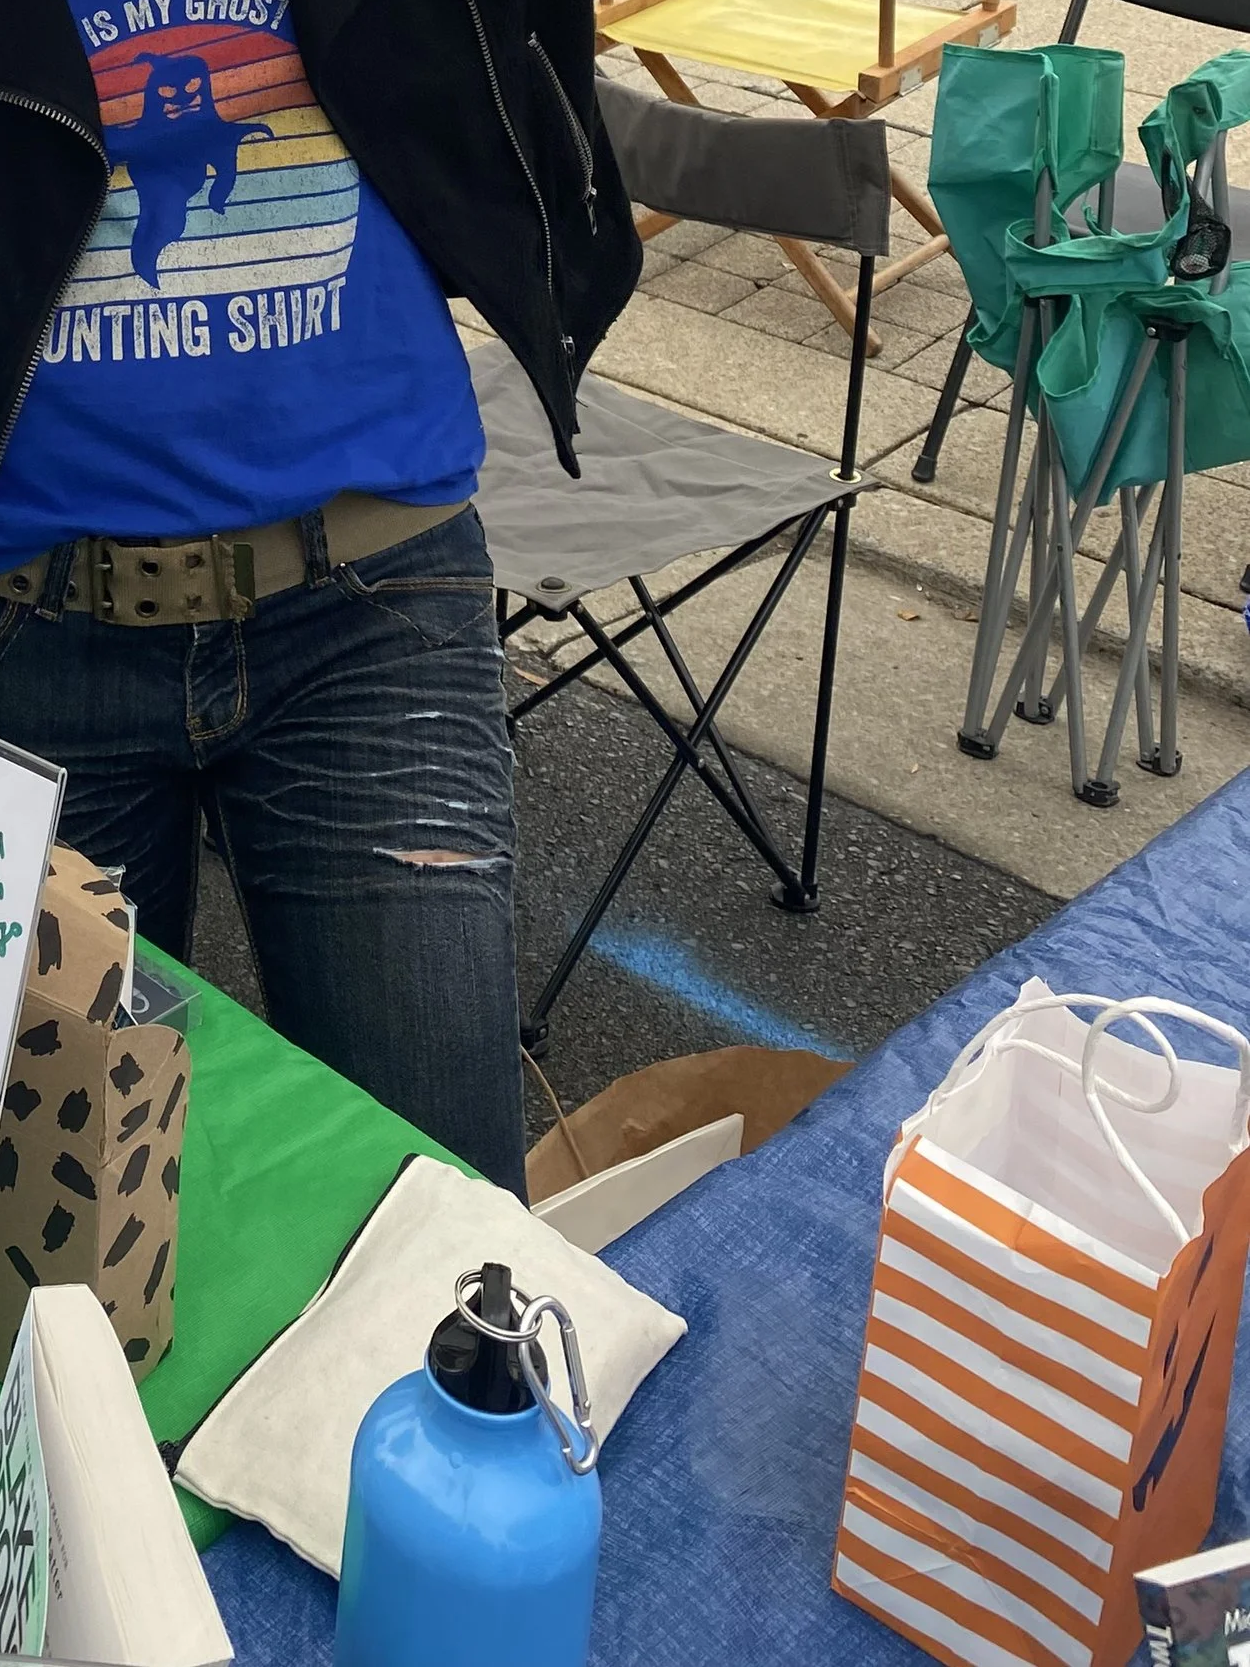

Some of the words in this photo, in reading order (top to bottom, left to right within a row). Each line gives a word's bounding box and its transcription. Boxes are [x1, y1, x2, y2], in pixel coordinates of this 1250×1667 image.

[81, 10, 118, 47] IS
[41, 300, 210, 363] UNTING
[227, 277, 347, 353] SHIRT
[4, 1362, 38, 1624] BLAKE
